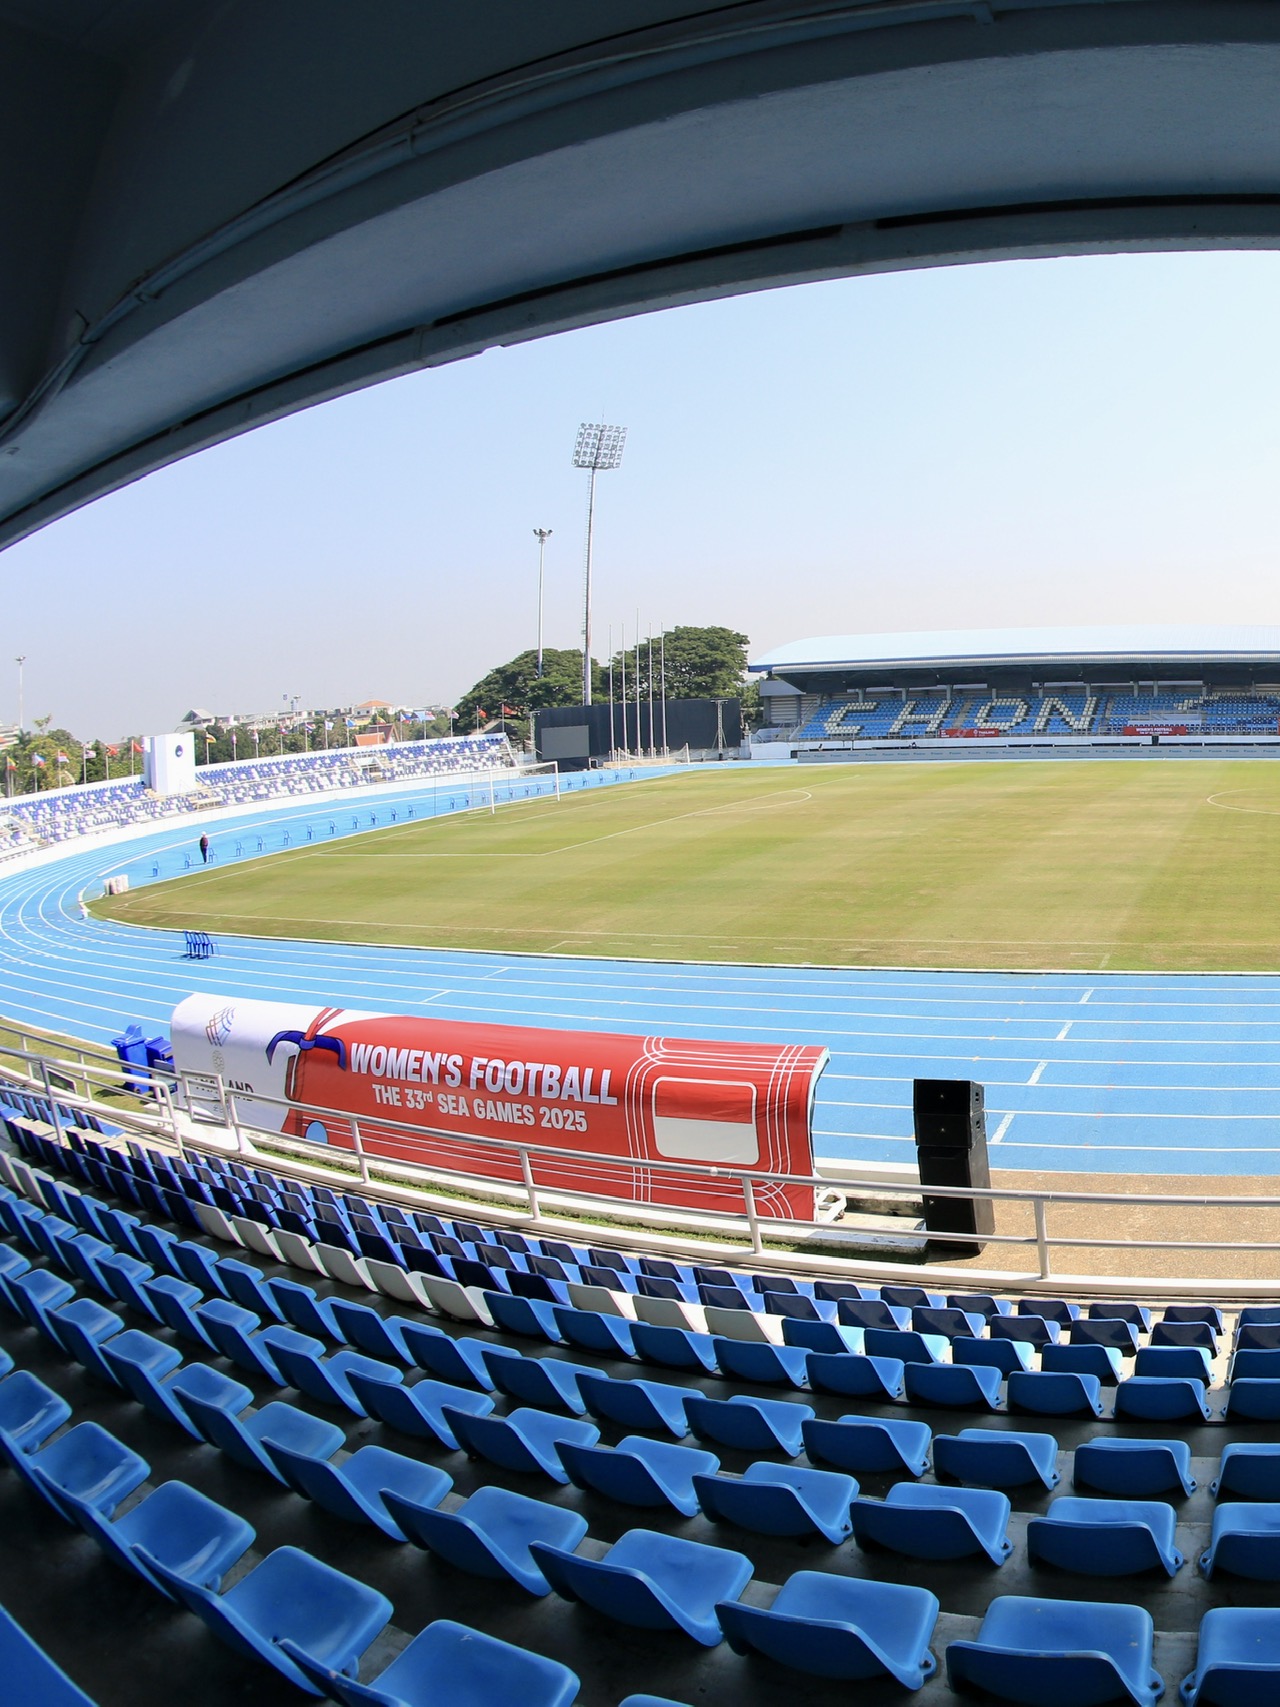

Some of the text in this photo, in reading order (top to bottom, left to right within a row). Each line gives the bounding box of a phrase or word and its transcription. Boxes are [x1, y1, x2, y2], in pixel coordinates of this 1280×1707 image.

[823, 697, 1098, 735] CHON
[350, 1042, 618, 1106] WOMEN'S FOOTBALL
[372, 1084, 588, 1132] THE 33rd SEA GAMES 2025
